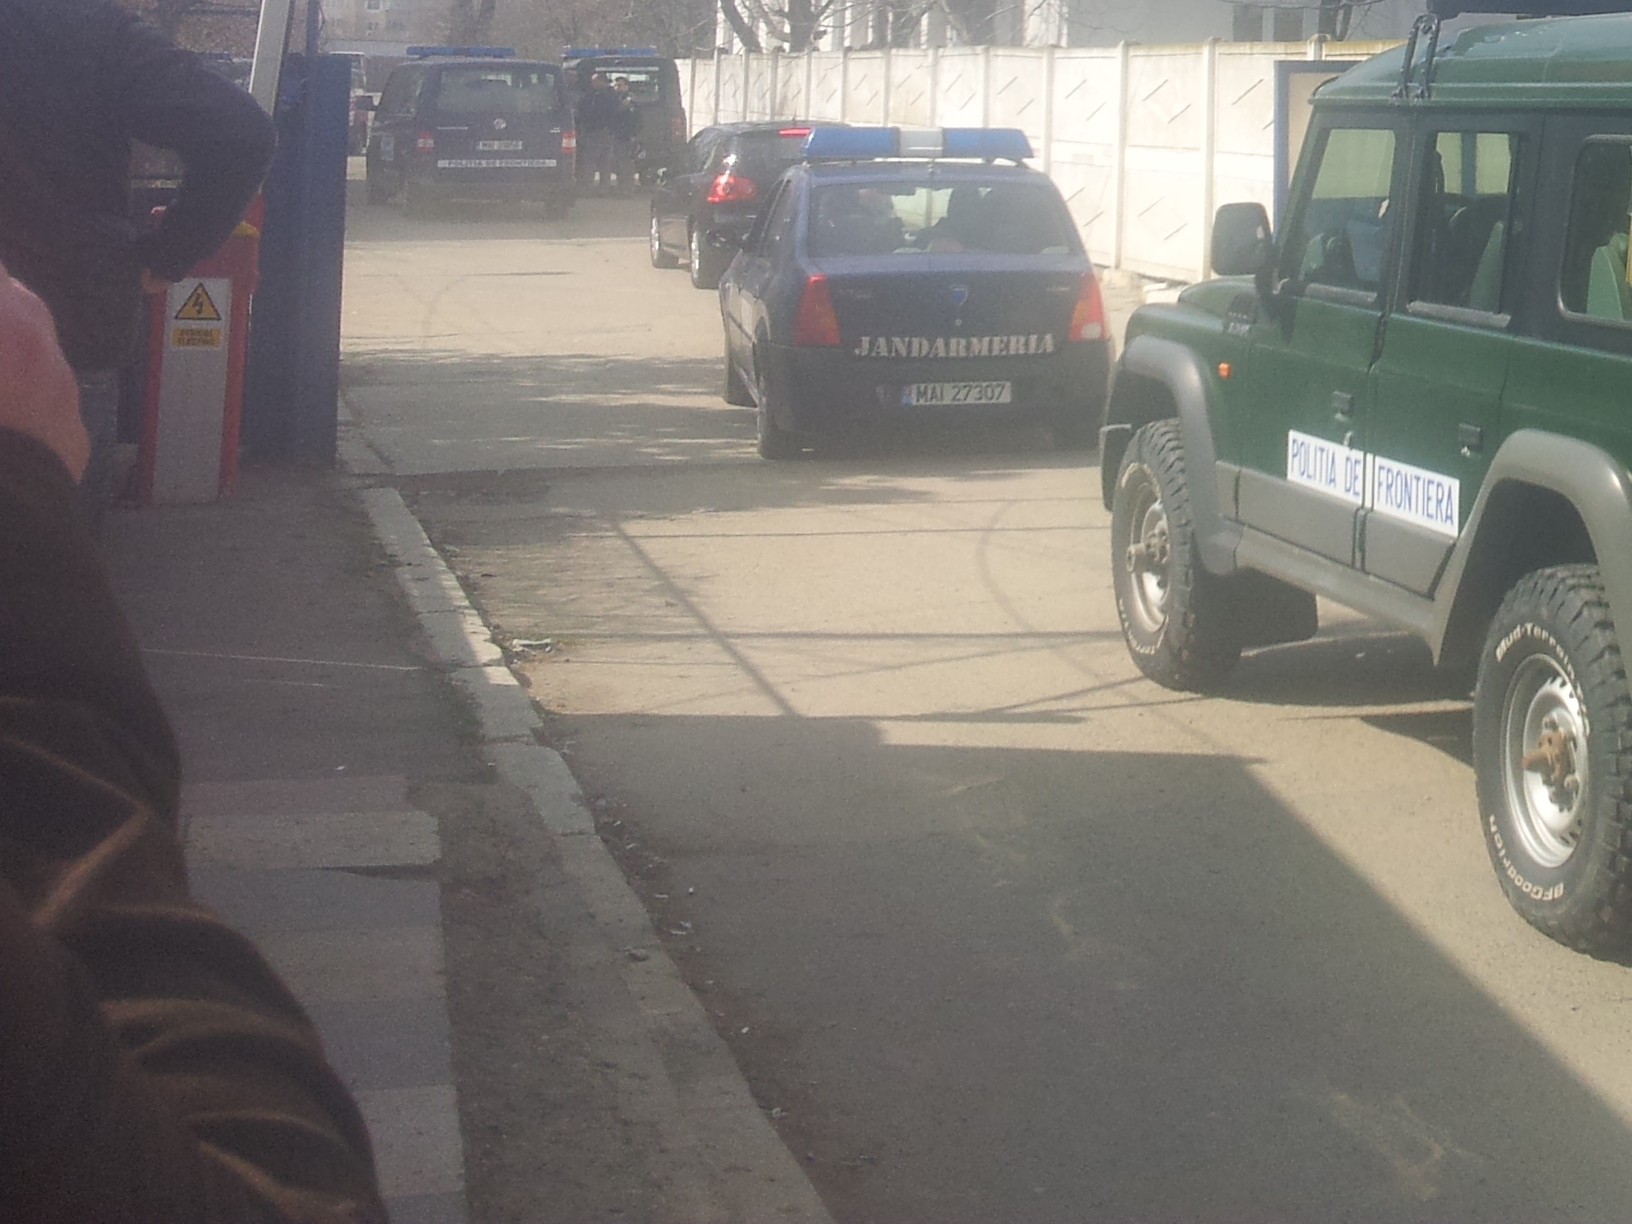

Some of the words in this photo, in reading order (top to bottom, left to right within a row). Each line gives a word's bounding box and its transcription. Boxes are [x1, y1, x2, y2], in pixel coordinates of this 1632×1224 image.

[854, 333, 1055, 358] JANDARMERIA
[916, 383, 945, 403] MAI
[952, 382, 1006, 402] 27307
[1291, 438, 1338, 489] POLITIA
[1344, 456, 1362, 497] DE
[1377, 465, 1455, 525] FRONTIERA
